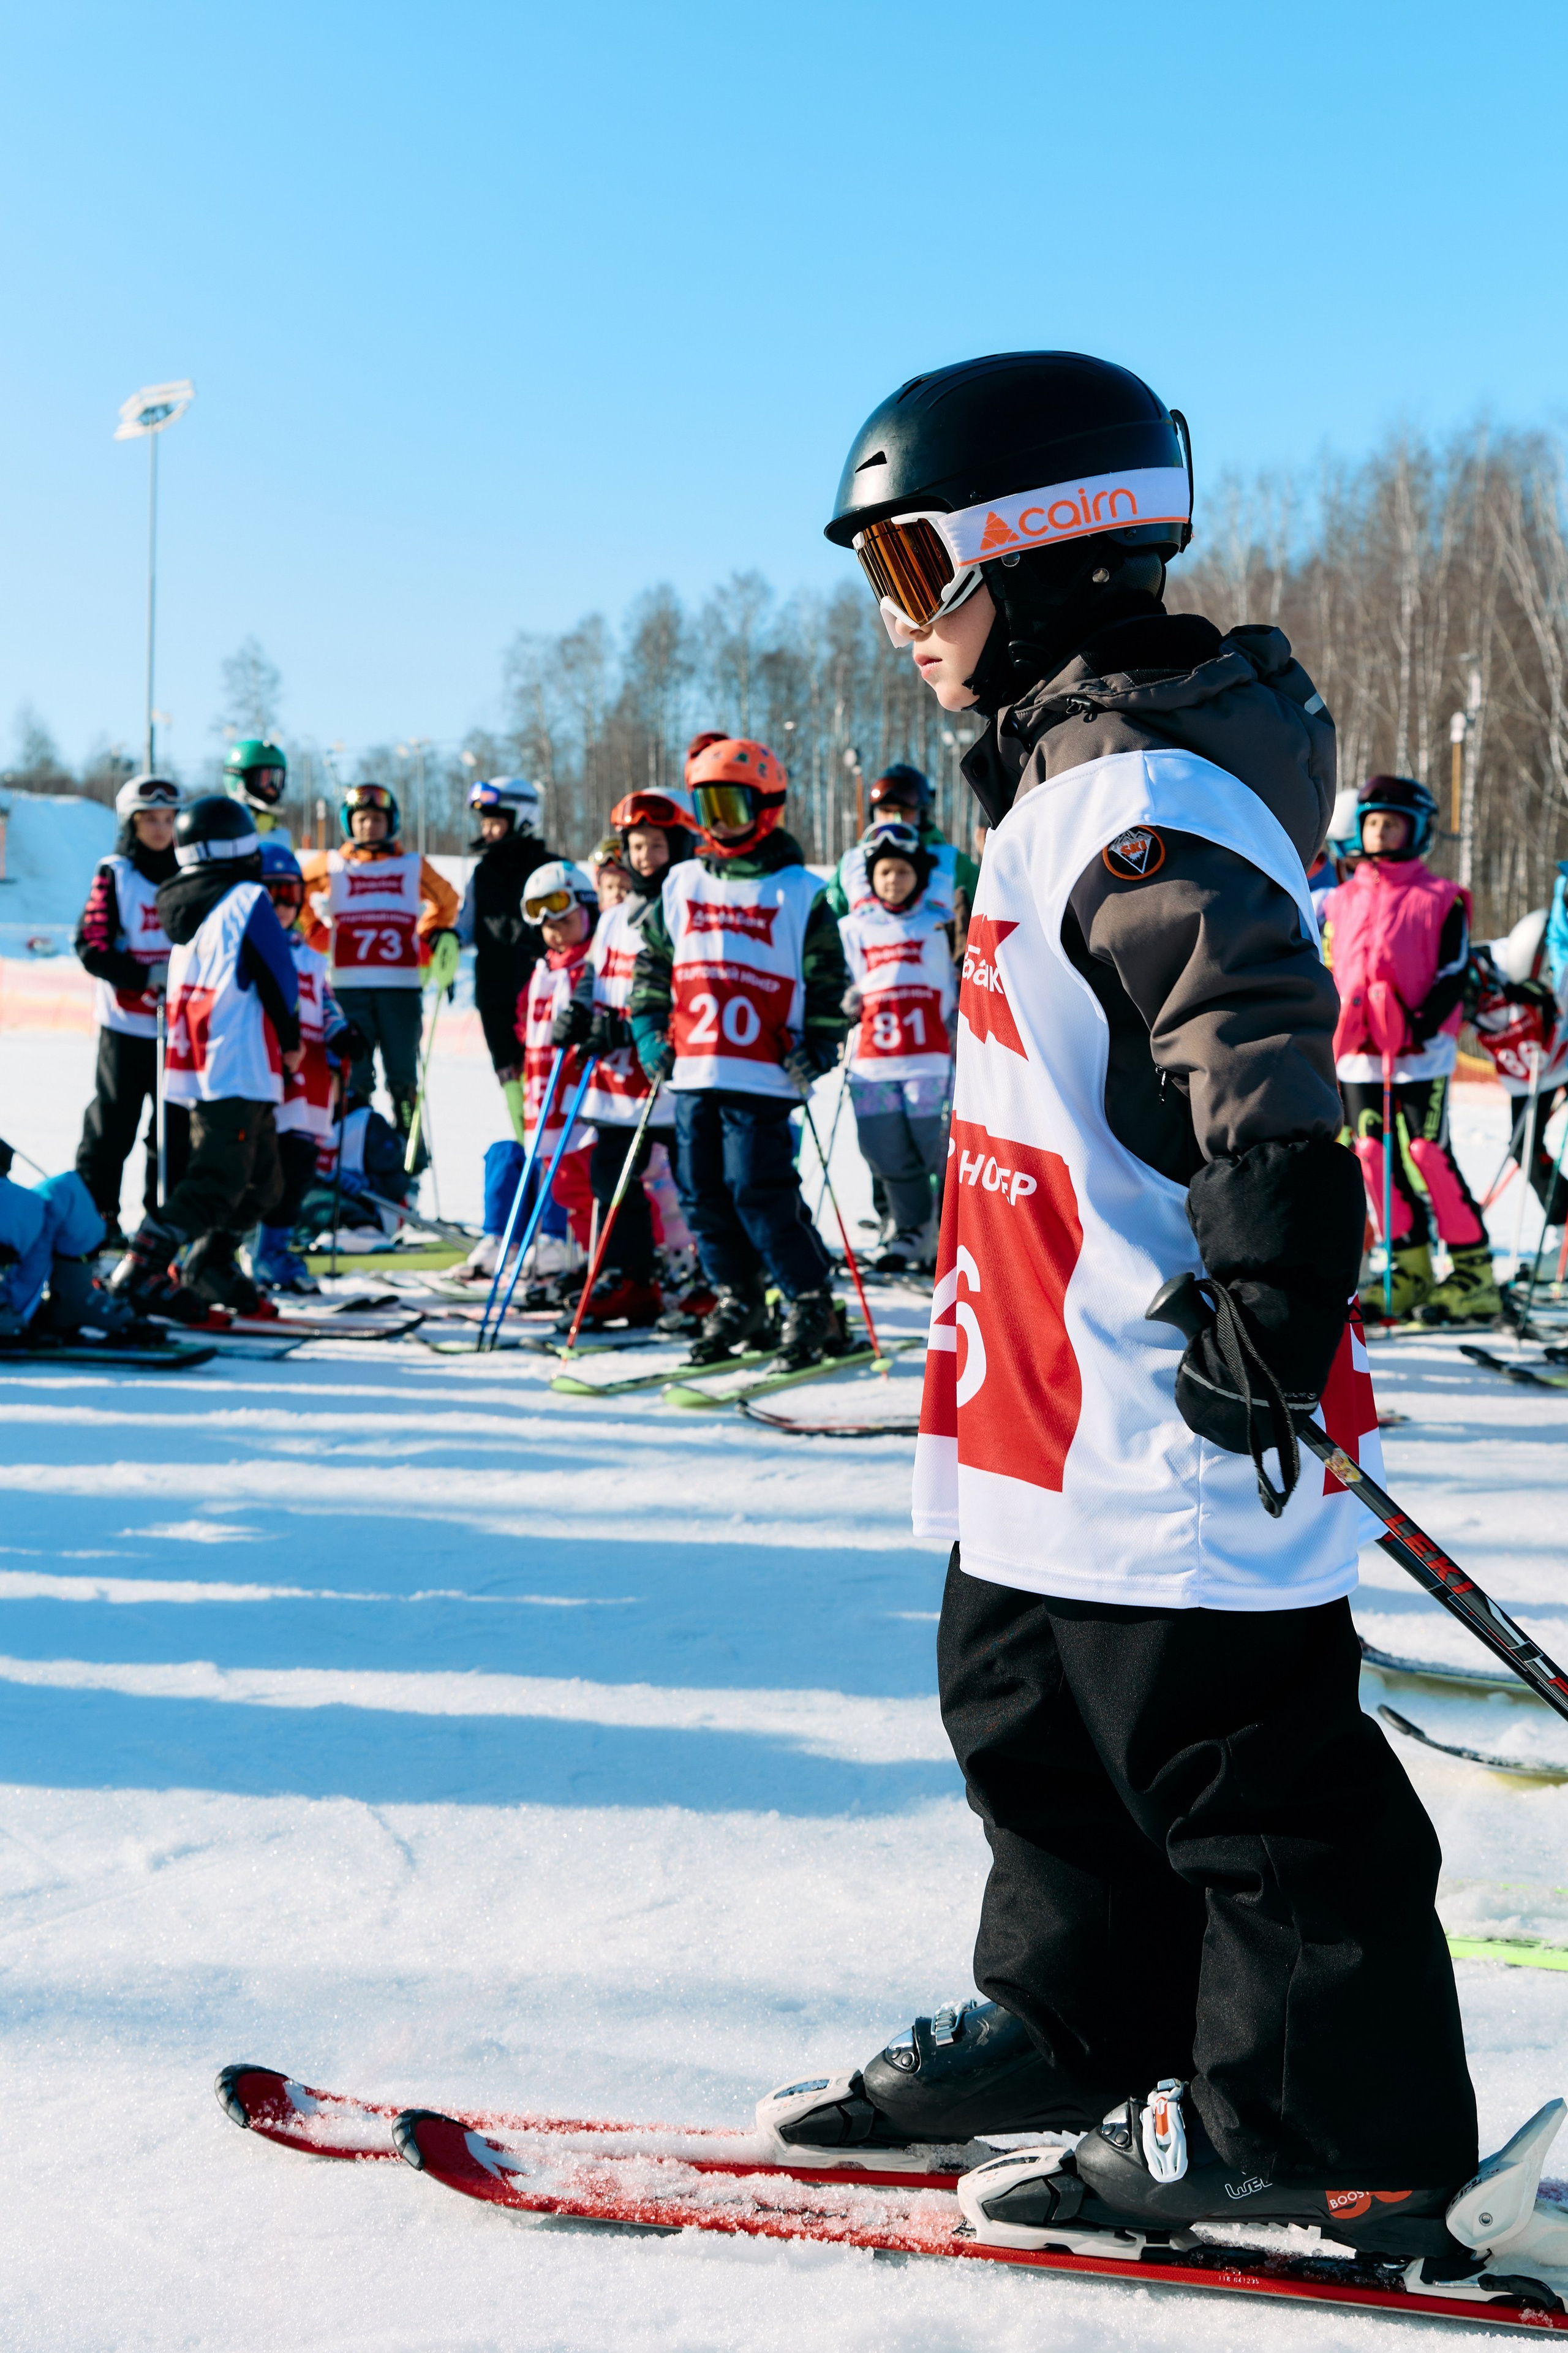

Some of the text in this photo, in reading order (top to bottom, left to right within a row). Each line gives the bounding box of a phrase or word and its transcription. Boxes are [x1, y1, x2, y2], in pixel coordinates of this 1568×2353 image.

[1019, 488, 1138, 537] cairn
[1120, 839, 1148, 856] SKI
[352, 927, 404, 961] 73
[686, 992, 761, 1046] 20
[872, 1007, 927, 1050] 81
[1383, 1513, 1474, 1595] LEKI
